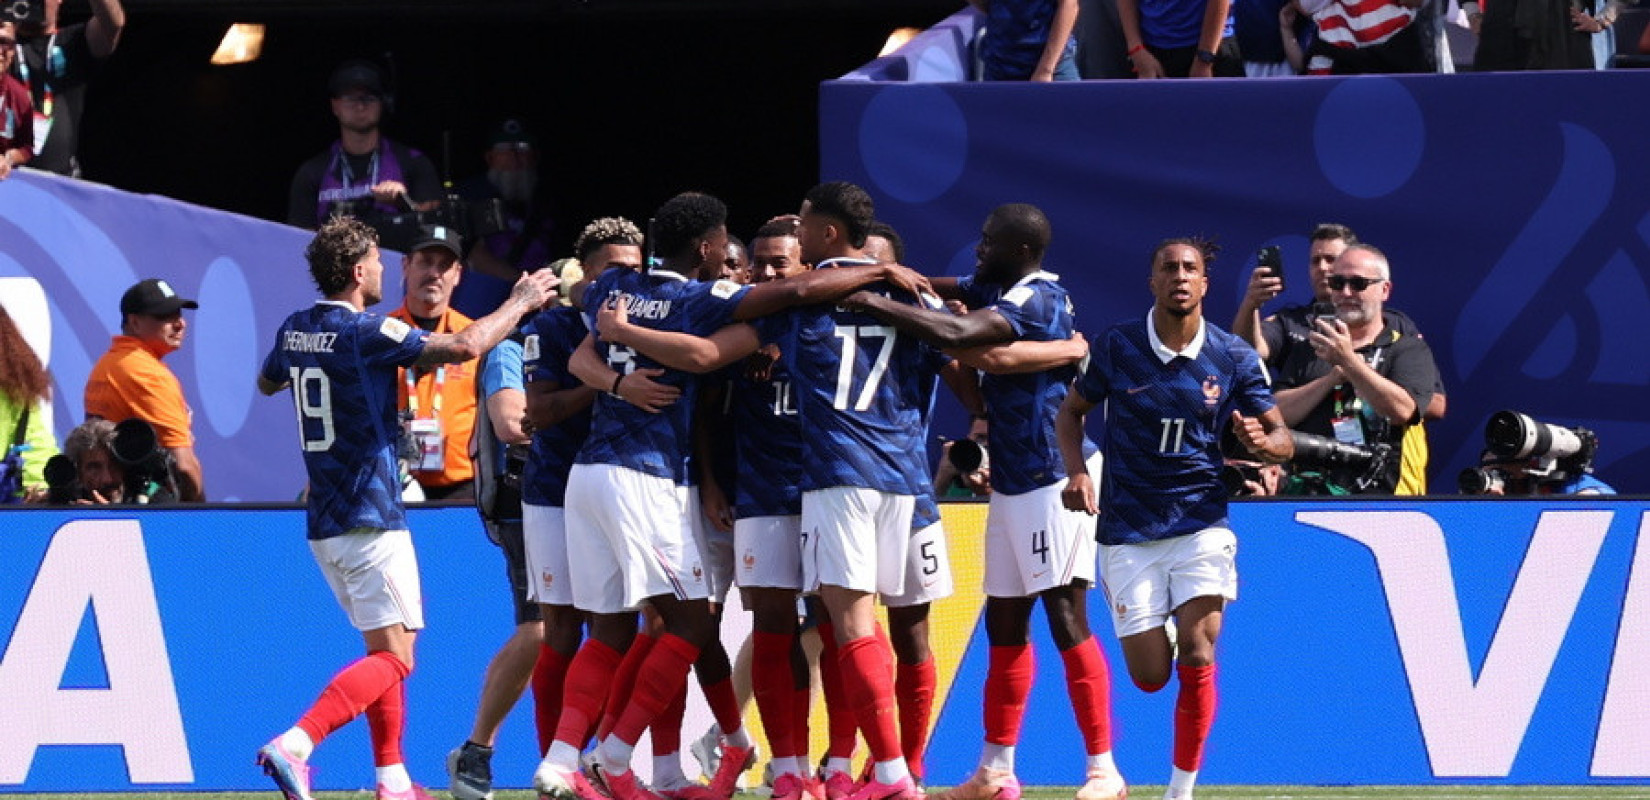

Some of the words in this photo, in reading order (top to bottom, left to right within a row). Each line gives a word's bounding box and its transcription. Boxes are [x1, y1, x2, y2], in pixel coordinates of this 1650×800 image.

[834, 325, 896, 411] 17
[290, 366, 334, 452] 19
[1159, 417, 1185, 453] 11
[921, 541, 938, 575] 5
[1032, 529, 1049, 564] 4
